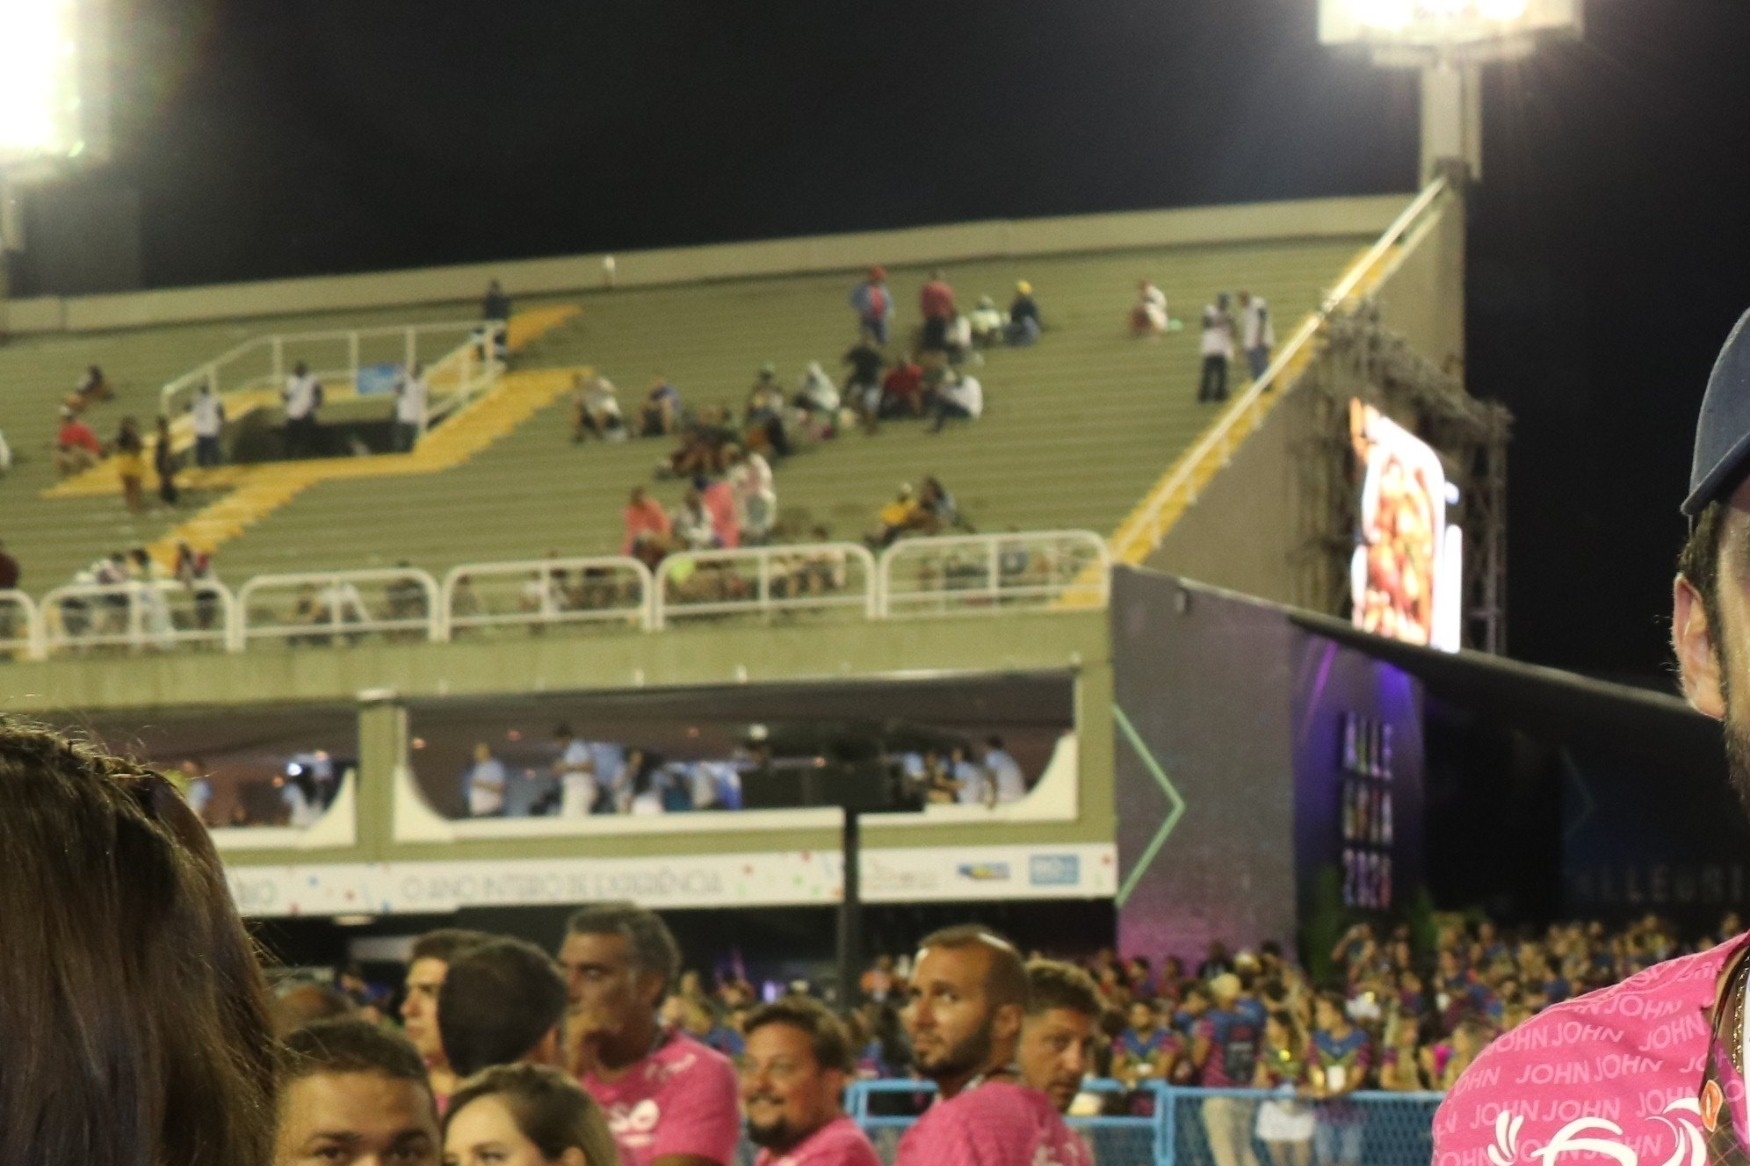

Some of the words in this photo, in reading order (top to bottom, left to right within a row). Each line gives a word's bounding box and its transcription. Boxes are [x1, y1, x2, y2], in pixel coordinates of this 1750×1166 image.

[1638, 1012, 1707, 1050] JOHN
[1516, 1061, 1590, 1084] JOHN
[1543, 1096, 1620, 1121] JOHN
